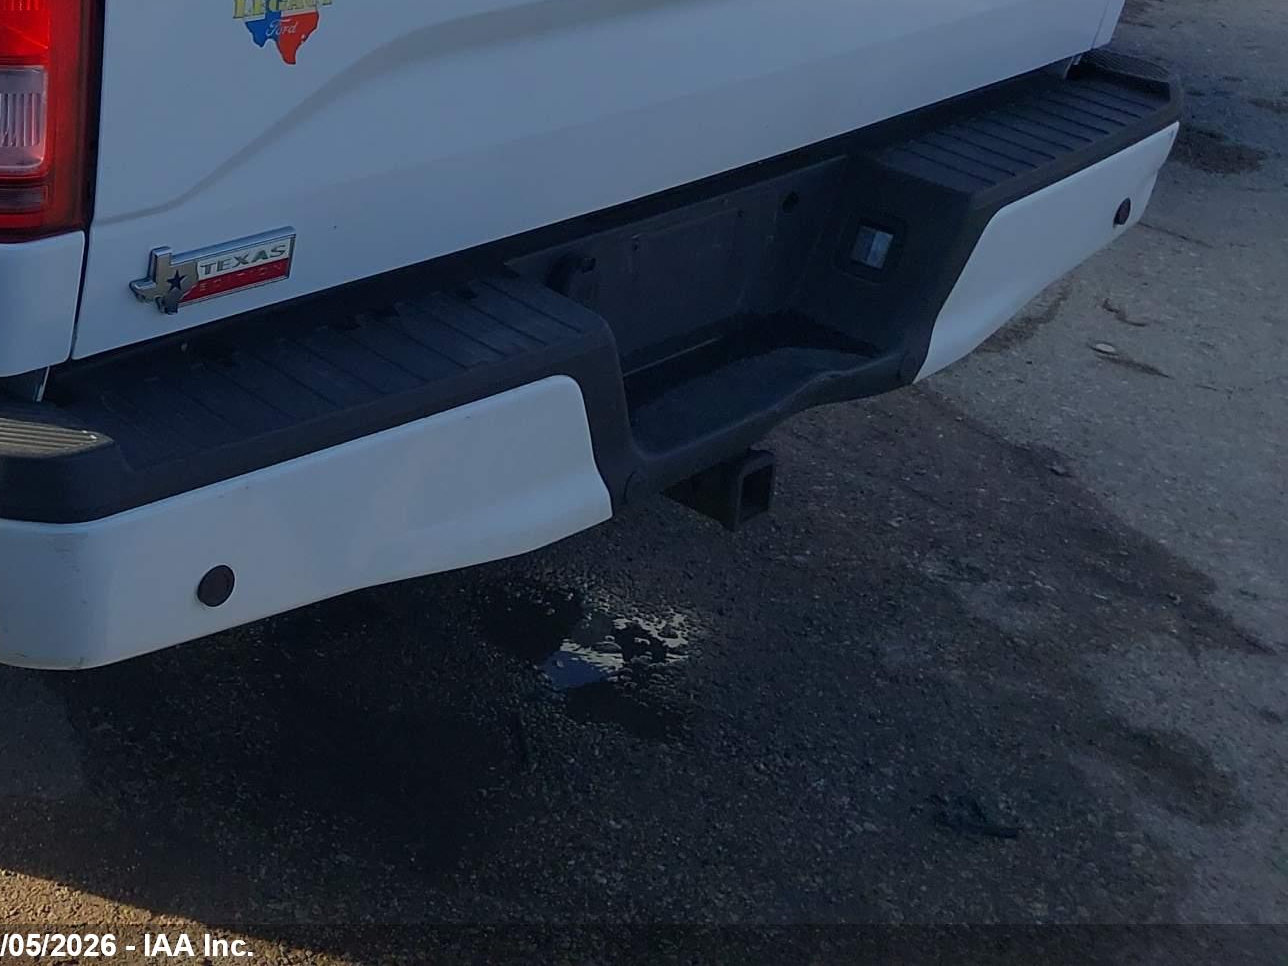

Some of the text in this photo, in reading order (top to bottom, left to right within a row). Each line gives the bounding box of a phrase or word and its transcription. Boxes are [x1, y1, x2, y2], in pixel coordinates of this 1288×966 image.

[265, 19, 298, 37] Ford
[200, 244, 287, 275] TEXAS
[199, 263, 282, 291] EDTON
